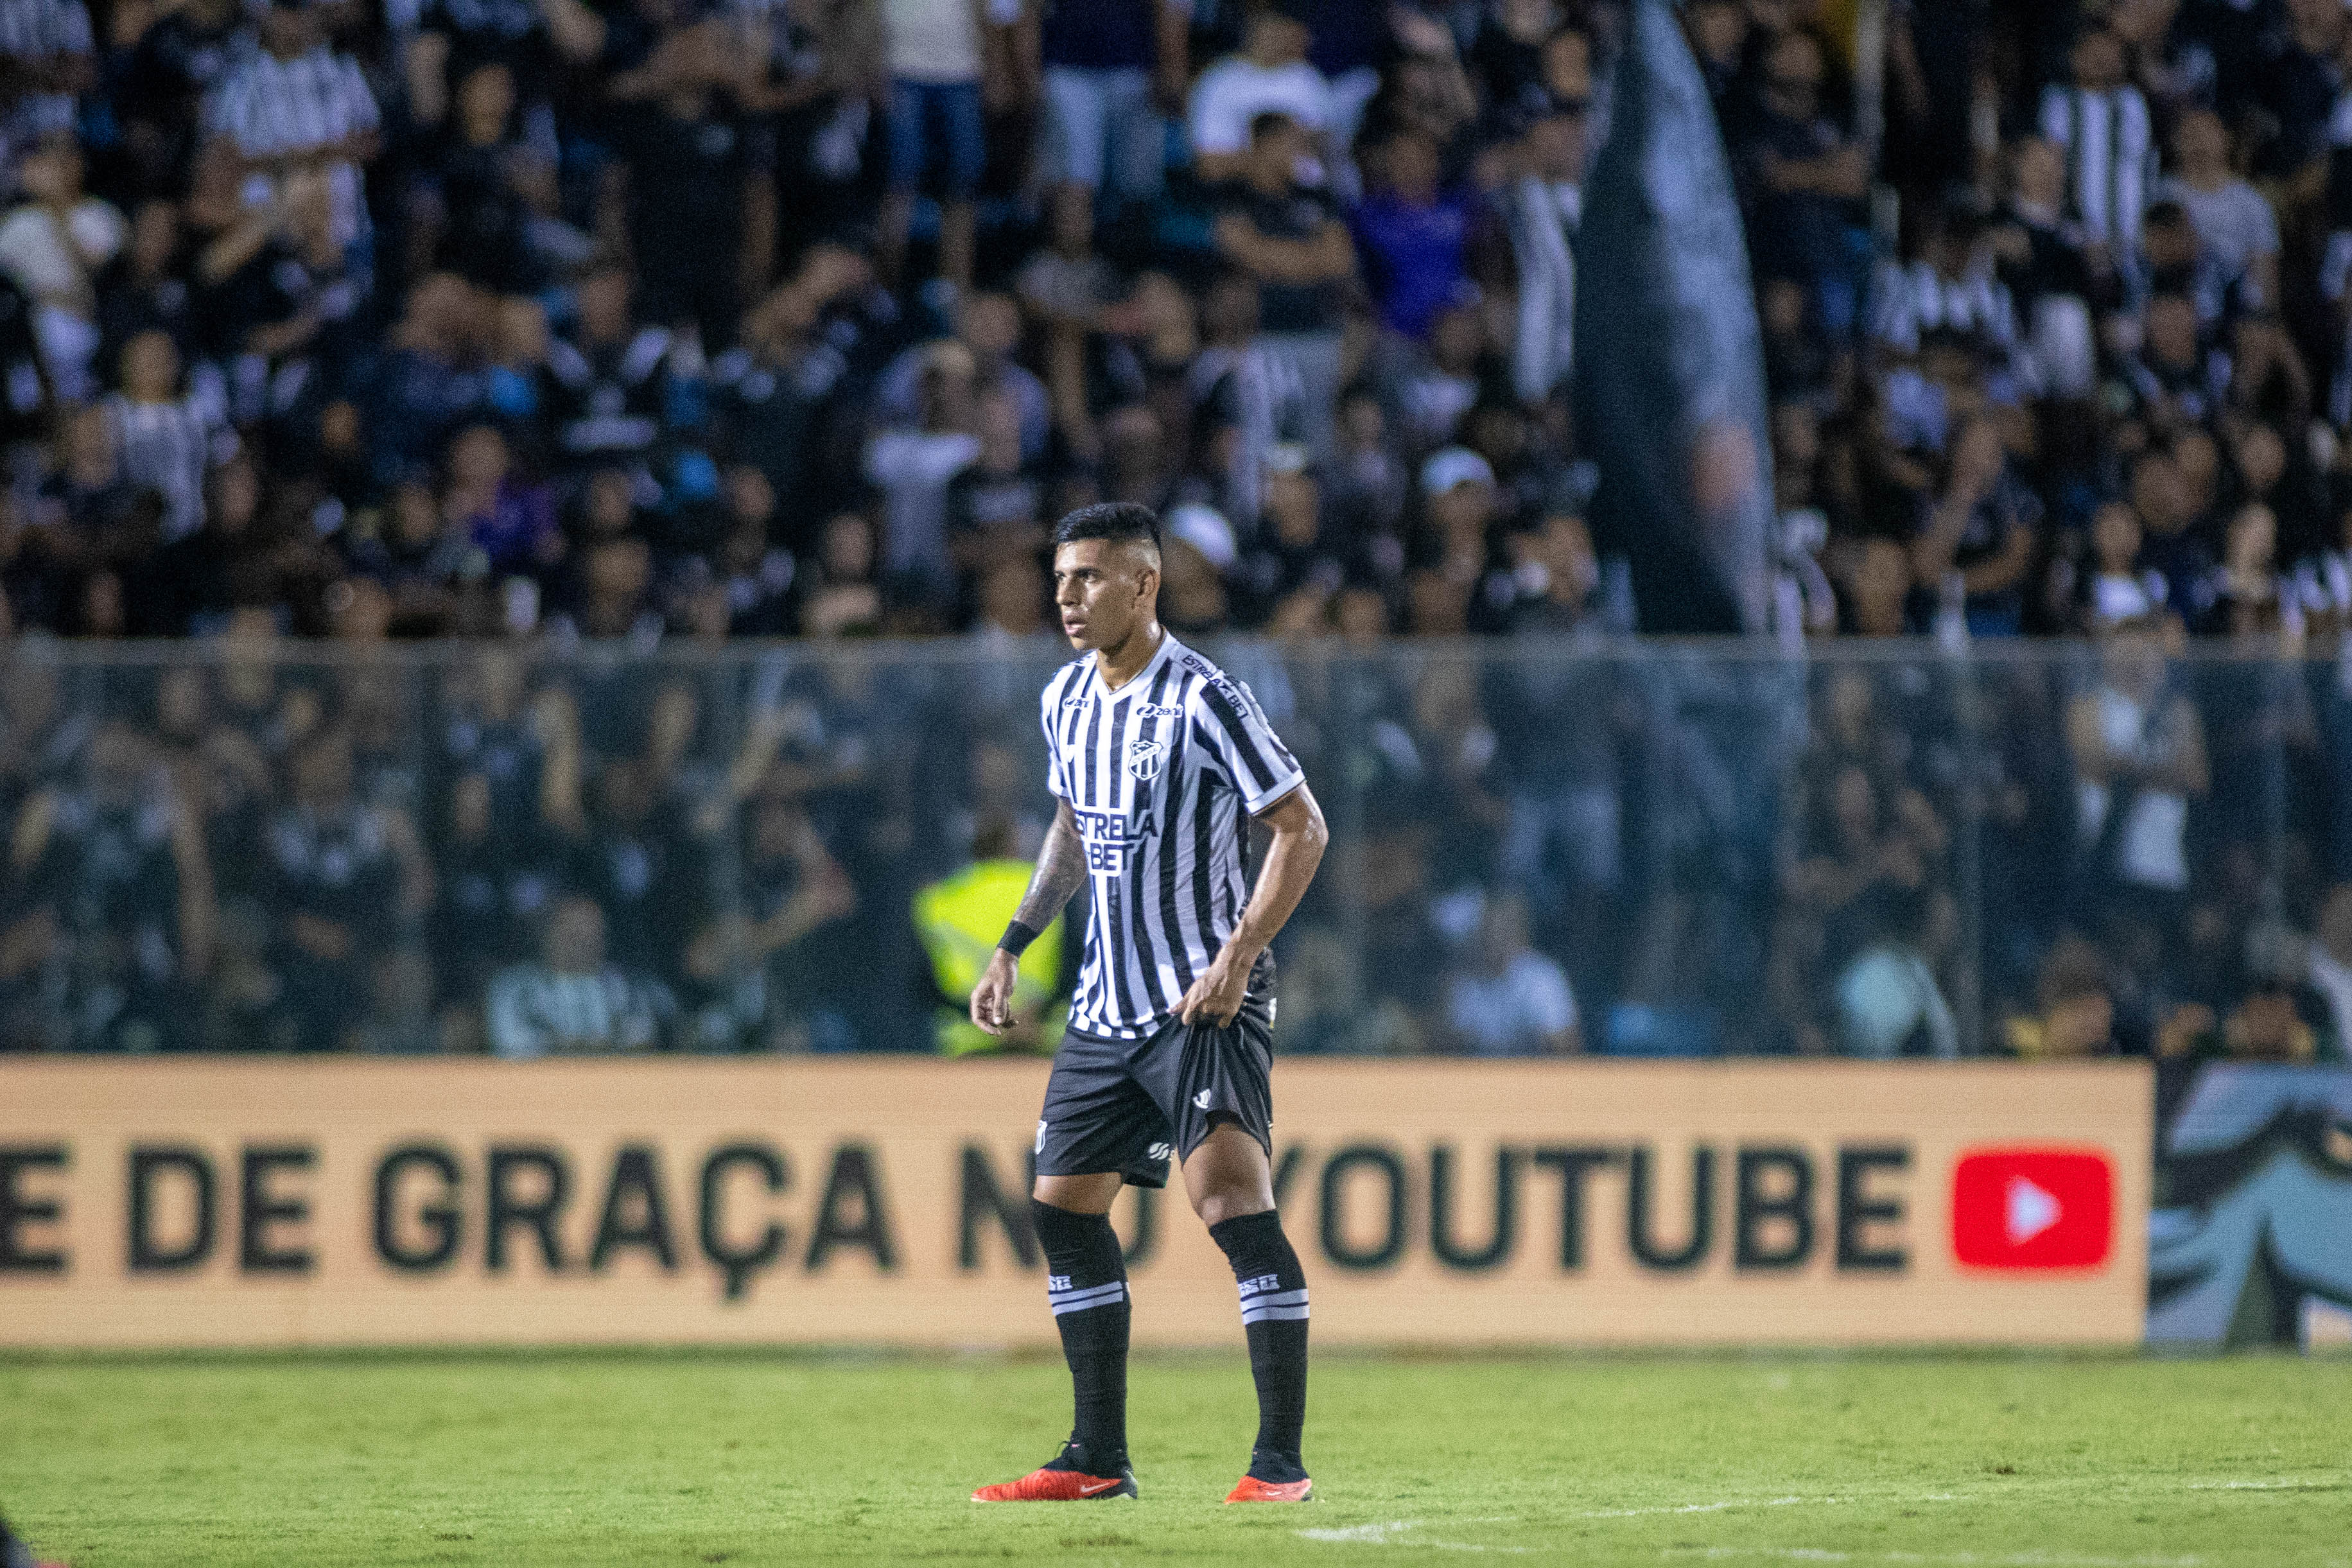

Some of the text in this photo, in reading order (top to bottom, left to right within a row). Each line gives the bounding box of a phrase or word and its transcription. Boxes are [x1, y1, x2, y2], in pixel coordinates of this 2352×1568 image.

[1090, 842, 1134, 871] BET
[123, 1141, 318, 1278] DE
[368, 1139, 902, 1302] GRAÇA
